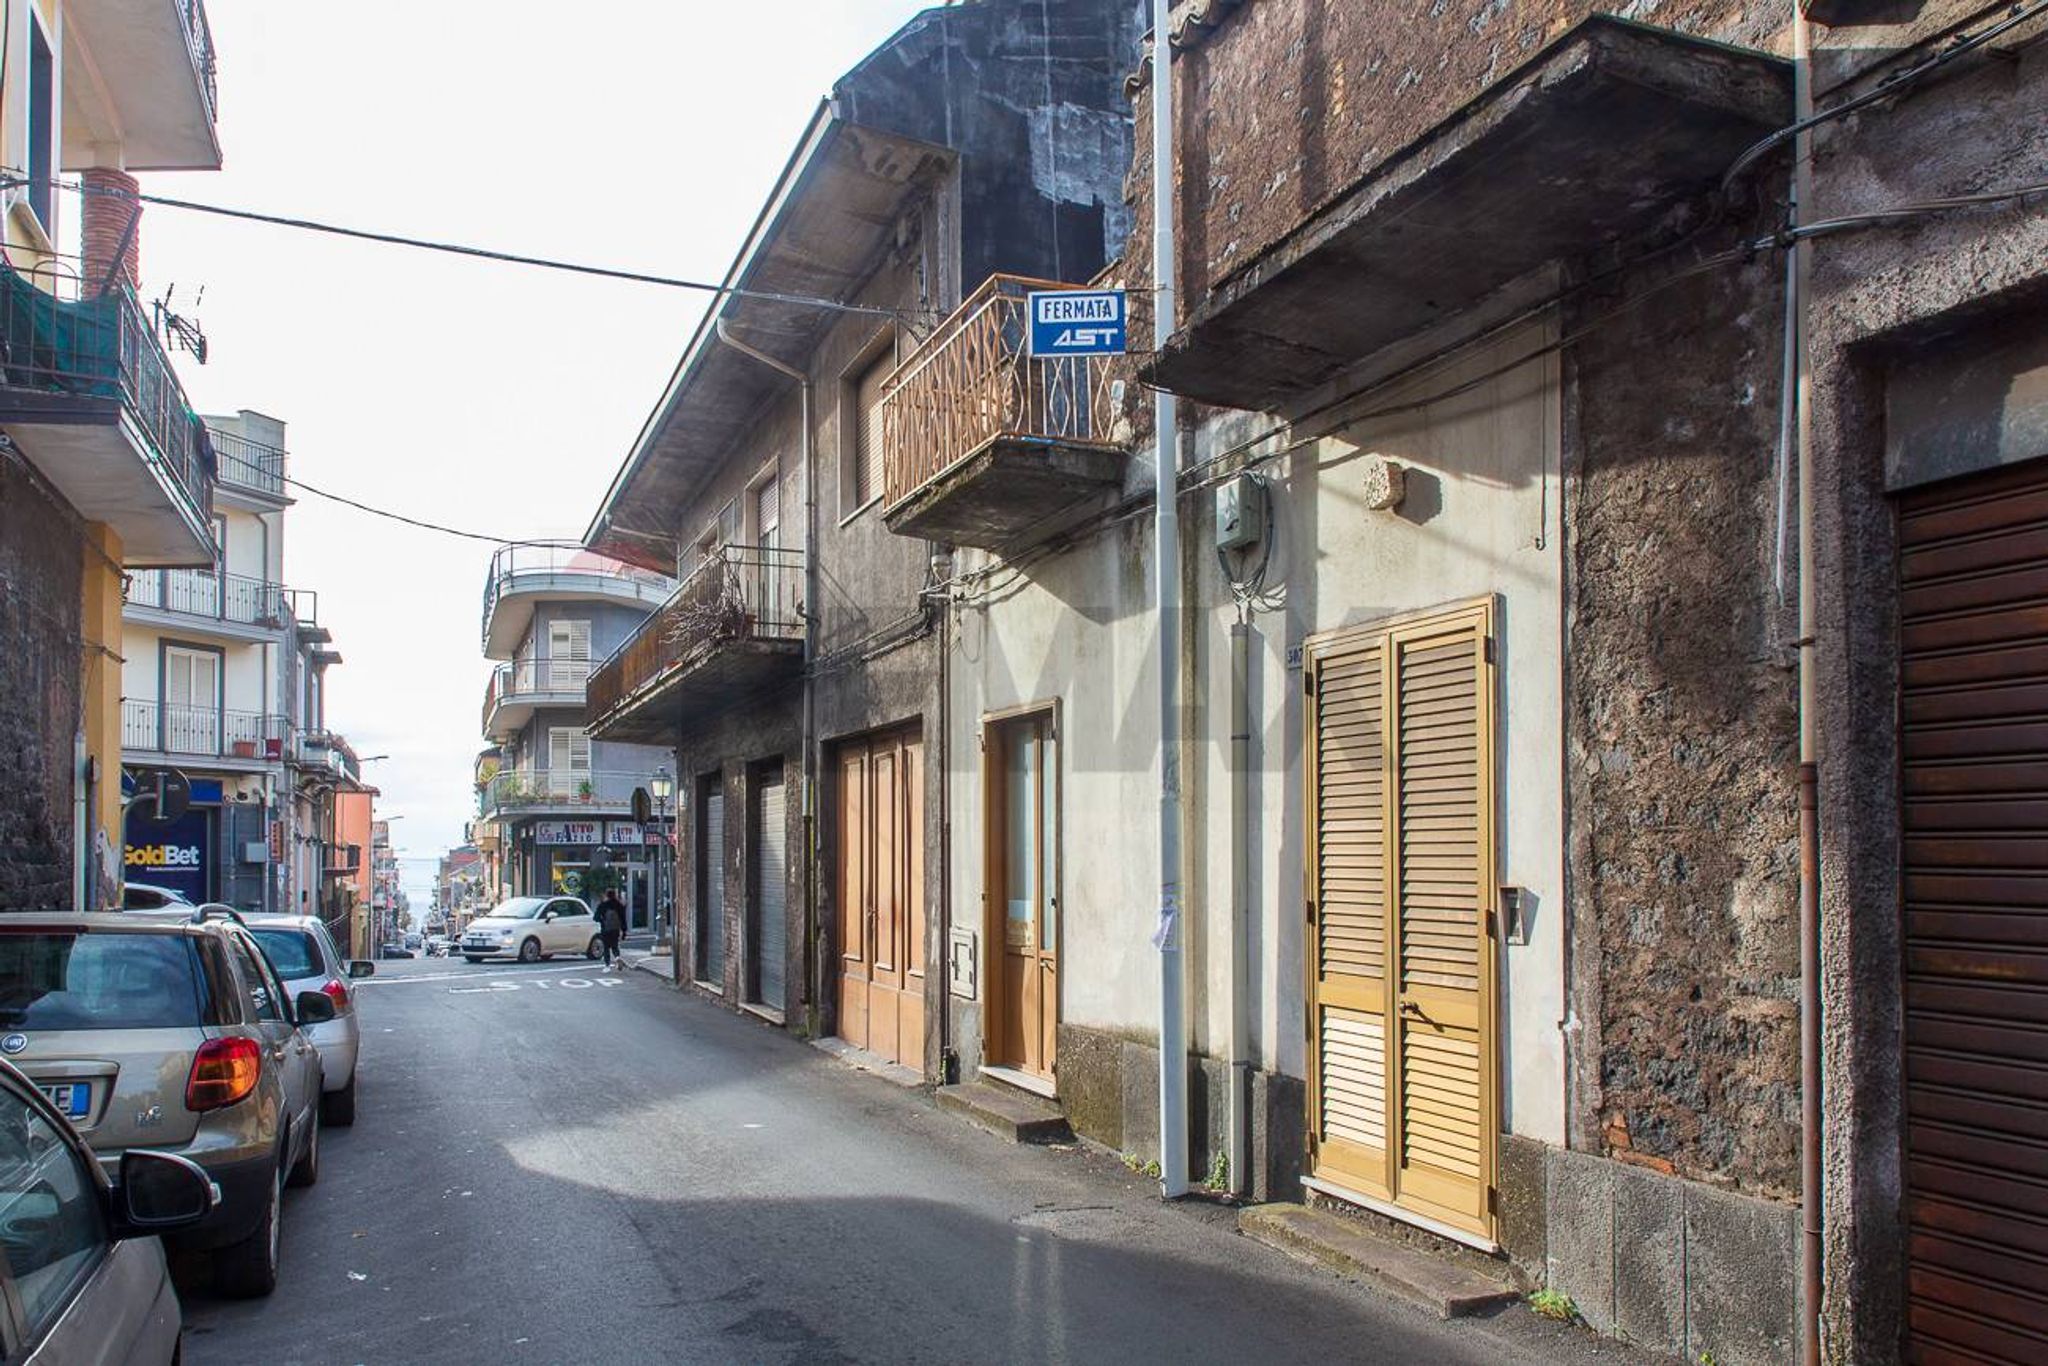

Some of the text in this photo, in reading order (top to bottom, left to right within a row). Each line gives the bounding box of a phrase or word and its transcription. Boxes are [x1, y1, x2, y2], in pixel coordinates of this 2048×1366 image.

[1043, 299, 1113, 320] FERMATA
[1053, 328, 1119, 347] AST
[563, 823, 594, 840] AUTO
[124, 844, 200, 866] GoldBet
[488, 978, 624, 991] STOP
